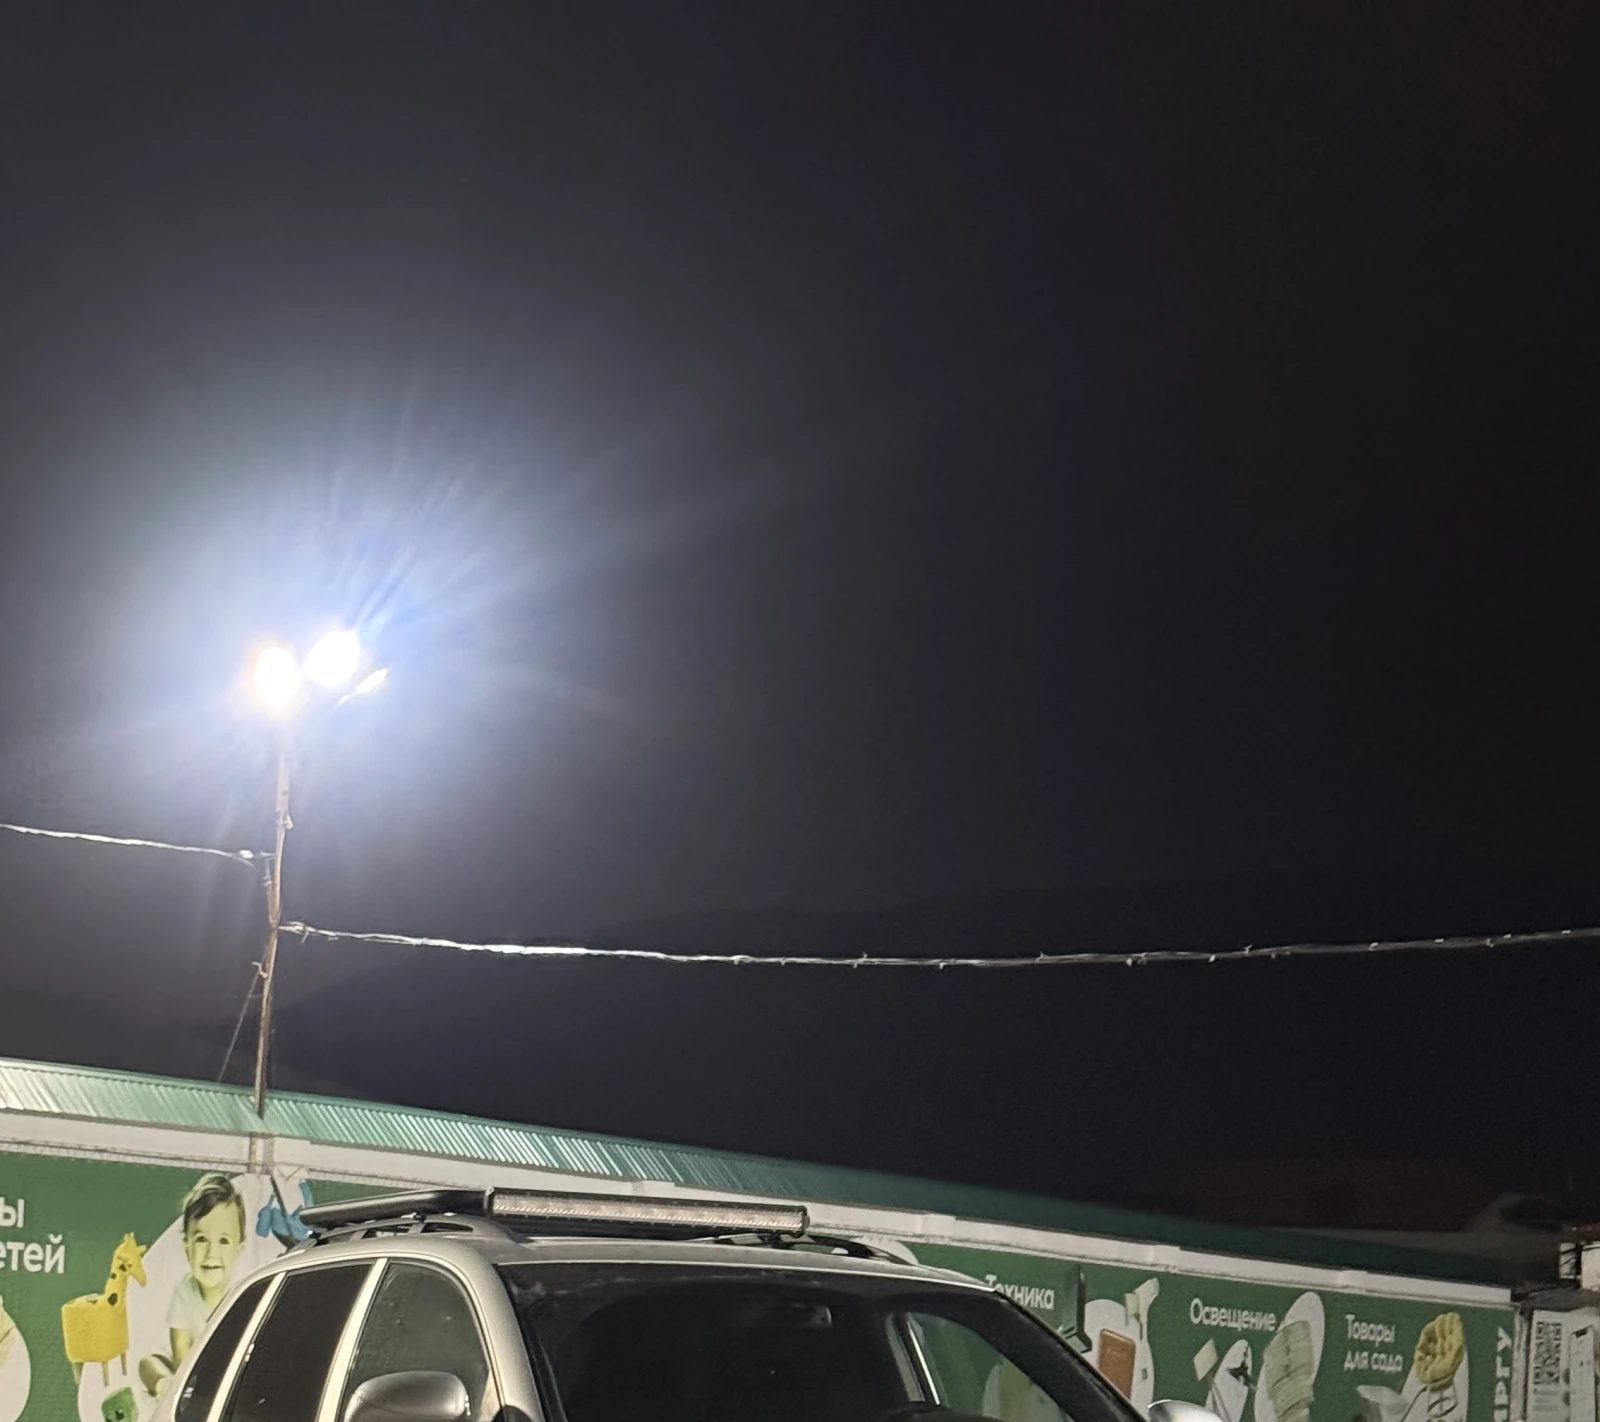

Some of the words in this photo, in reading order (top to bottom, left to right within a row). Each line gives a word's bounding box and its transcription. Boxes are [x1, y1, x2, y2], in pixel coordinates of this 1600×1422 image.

[1189, 1297, 1277, 1332] Освещение
[1345, 1314, 1396, 1347] Товары
[1343, 1350, 1370, 1372] для
[1371, 1352, 1404, 1374] сада
